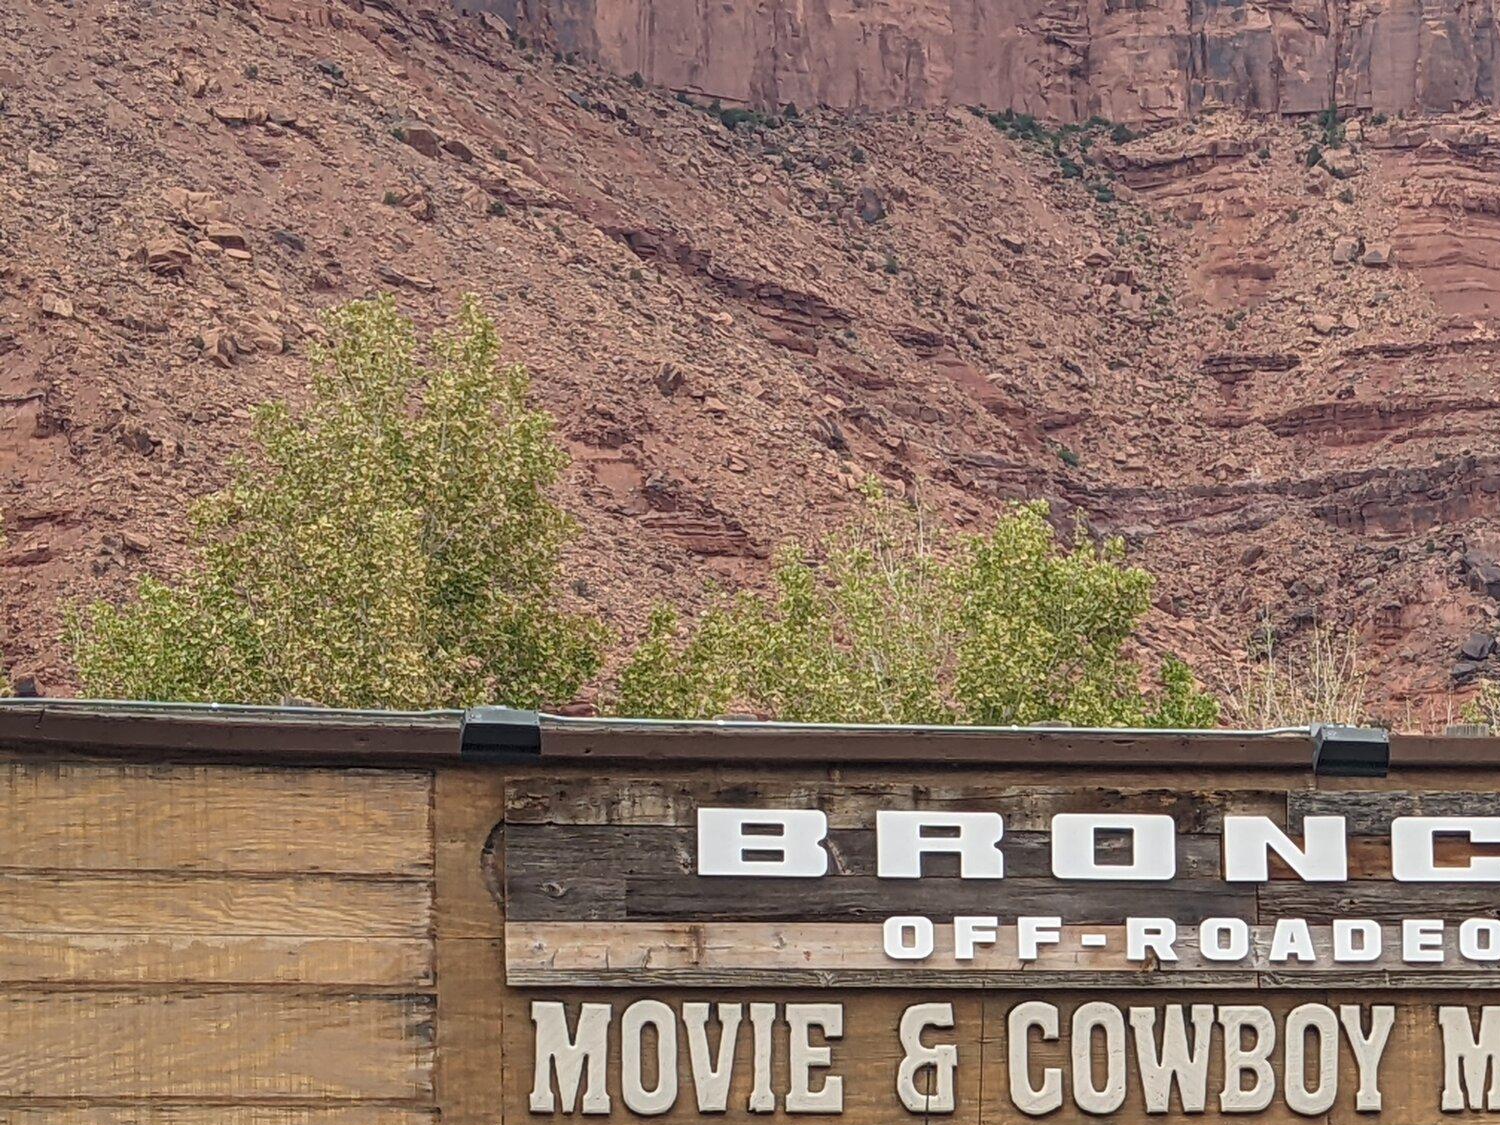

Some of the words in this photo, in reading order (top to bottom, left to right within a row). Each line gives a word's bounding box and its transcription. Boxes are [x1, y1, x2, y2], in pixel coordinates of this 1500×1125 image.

[529, 1000, 844, 1115] MOVIE
[897, 1002, 959, 1114] &
[1007, 1000, 1396, 1116] COWBOY
